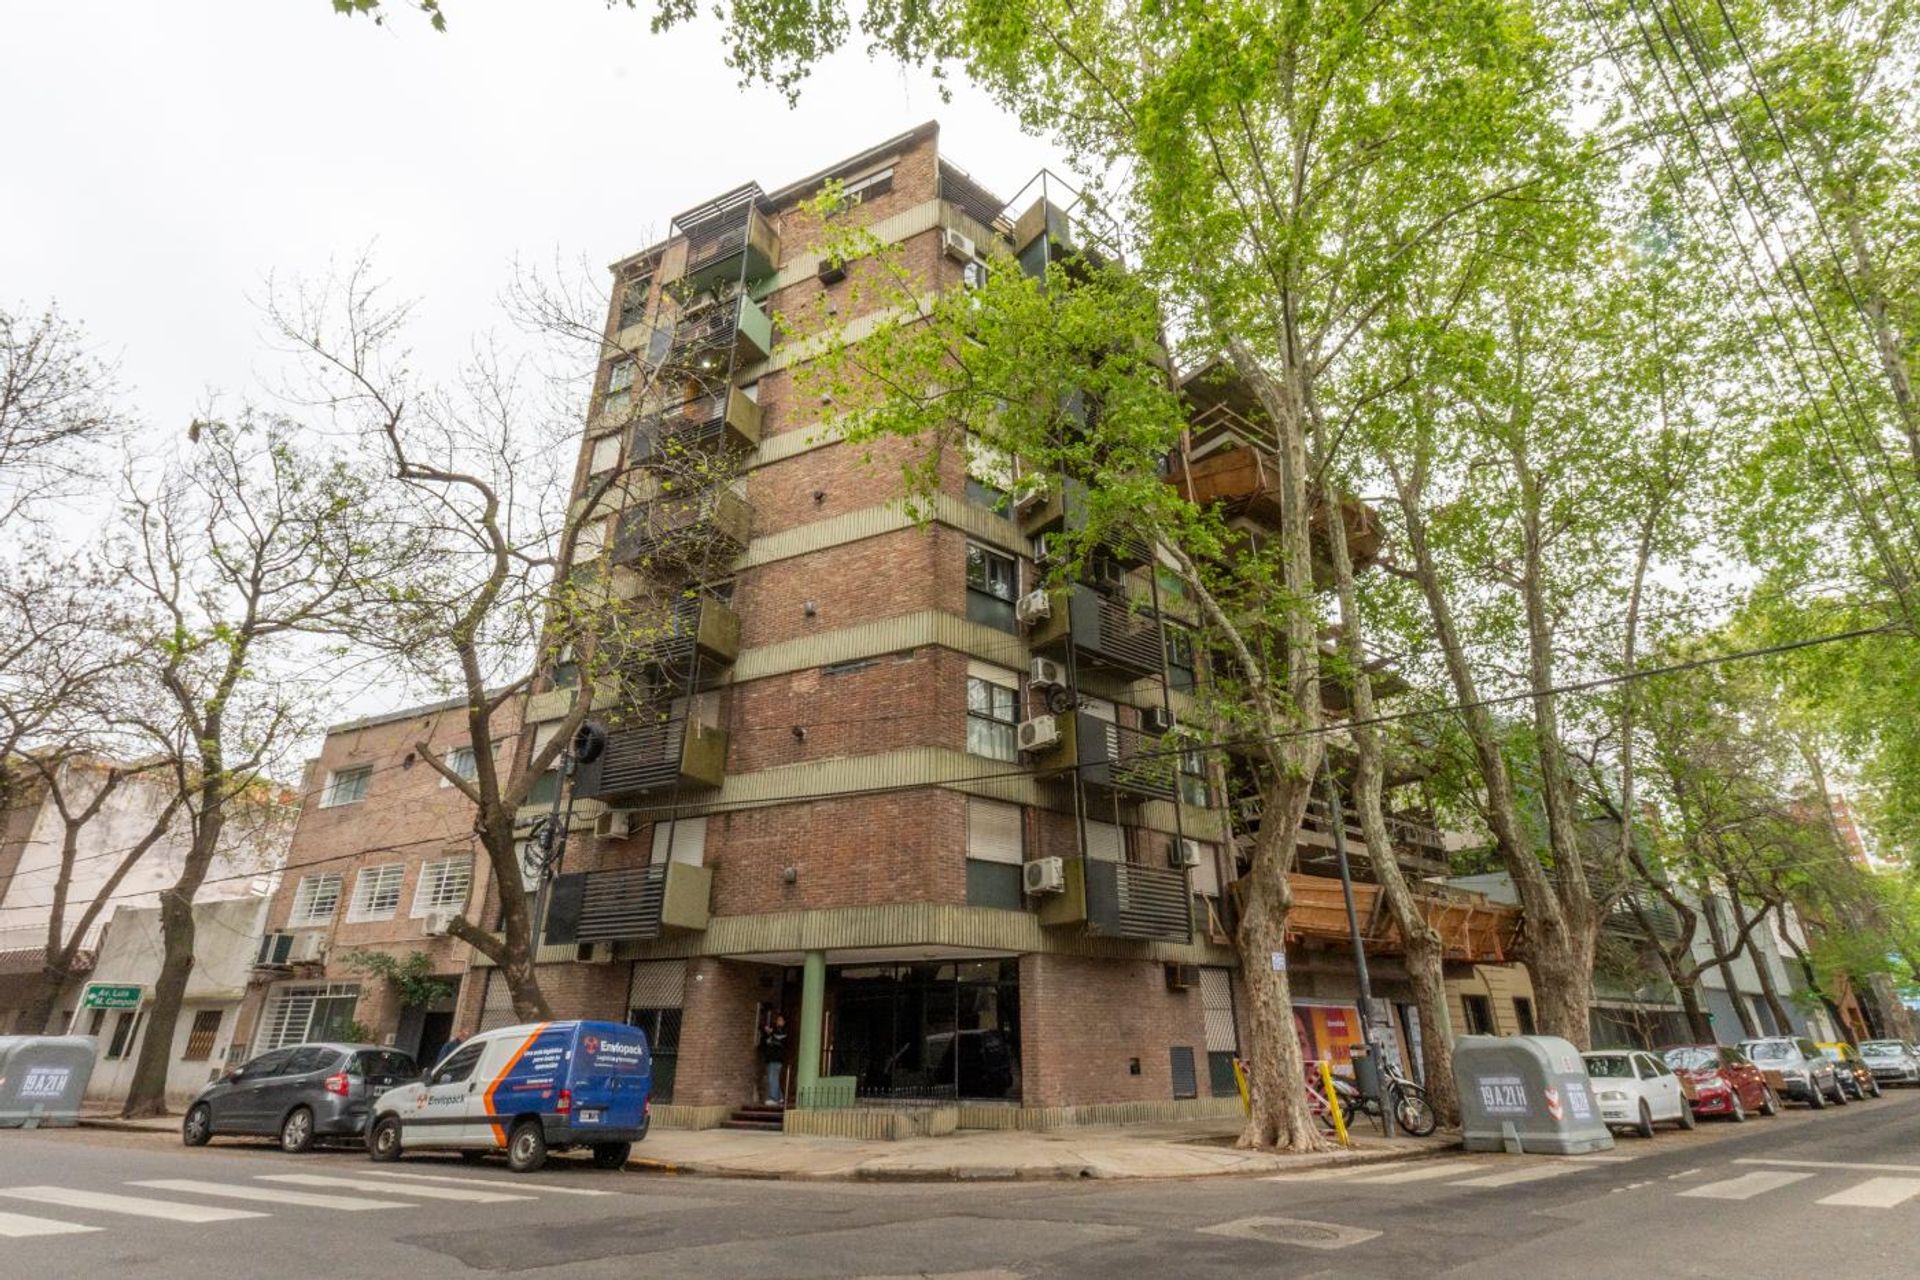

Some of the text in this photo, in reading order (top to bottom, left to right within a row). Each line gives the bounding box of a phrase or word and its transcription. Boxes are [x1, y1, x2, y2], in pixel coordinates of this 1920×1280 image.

[22, 1075, 38, 1090] 19
[1481, 1086, 1495, 1105] 19
[1494, 1086, 1505, 1105] A
[1502, 1086, 1517, 1105] 21
